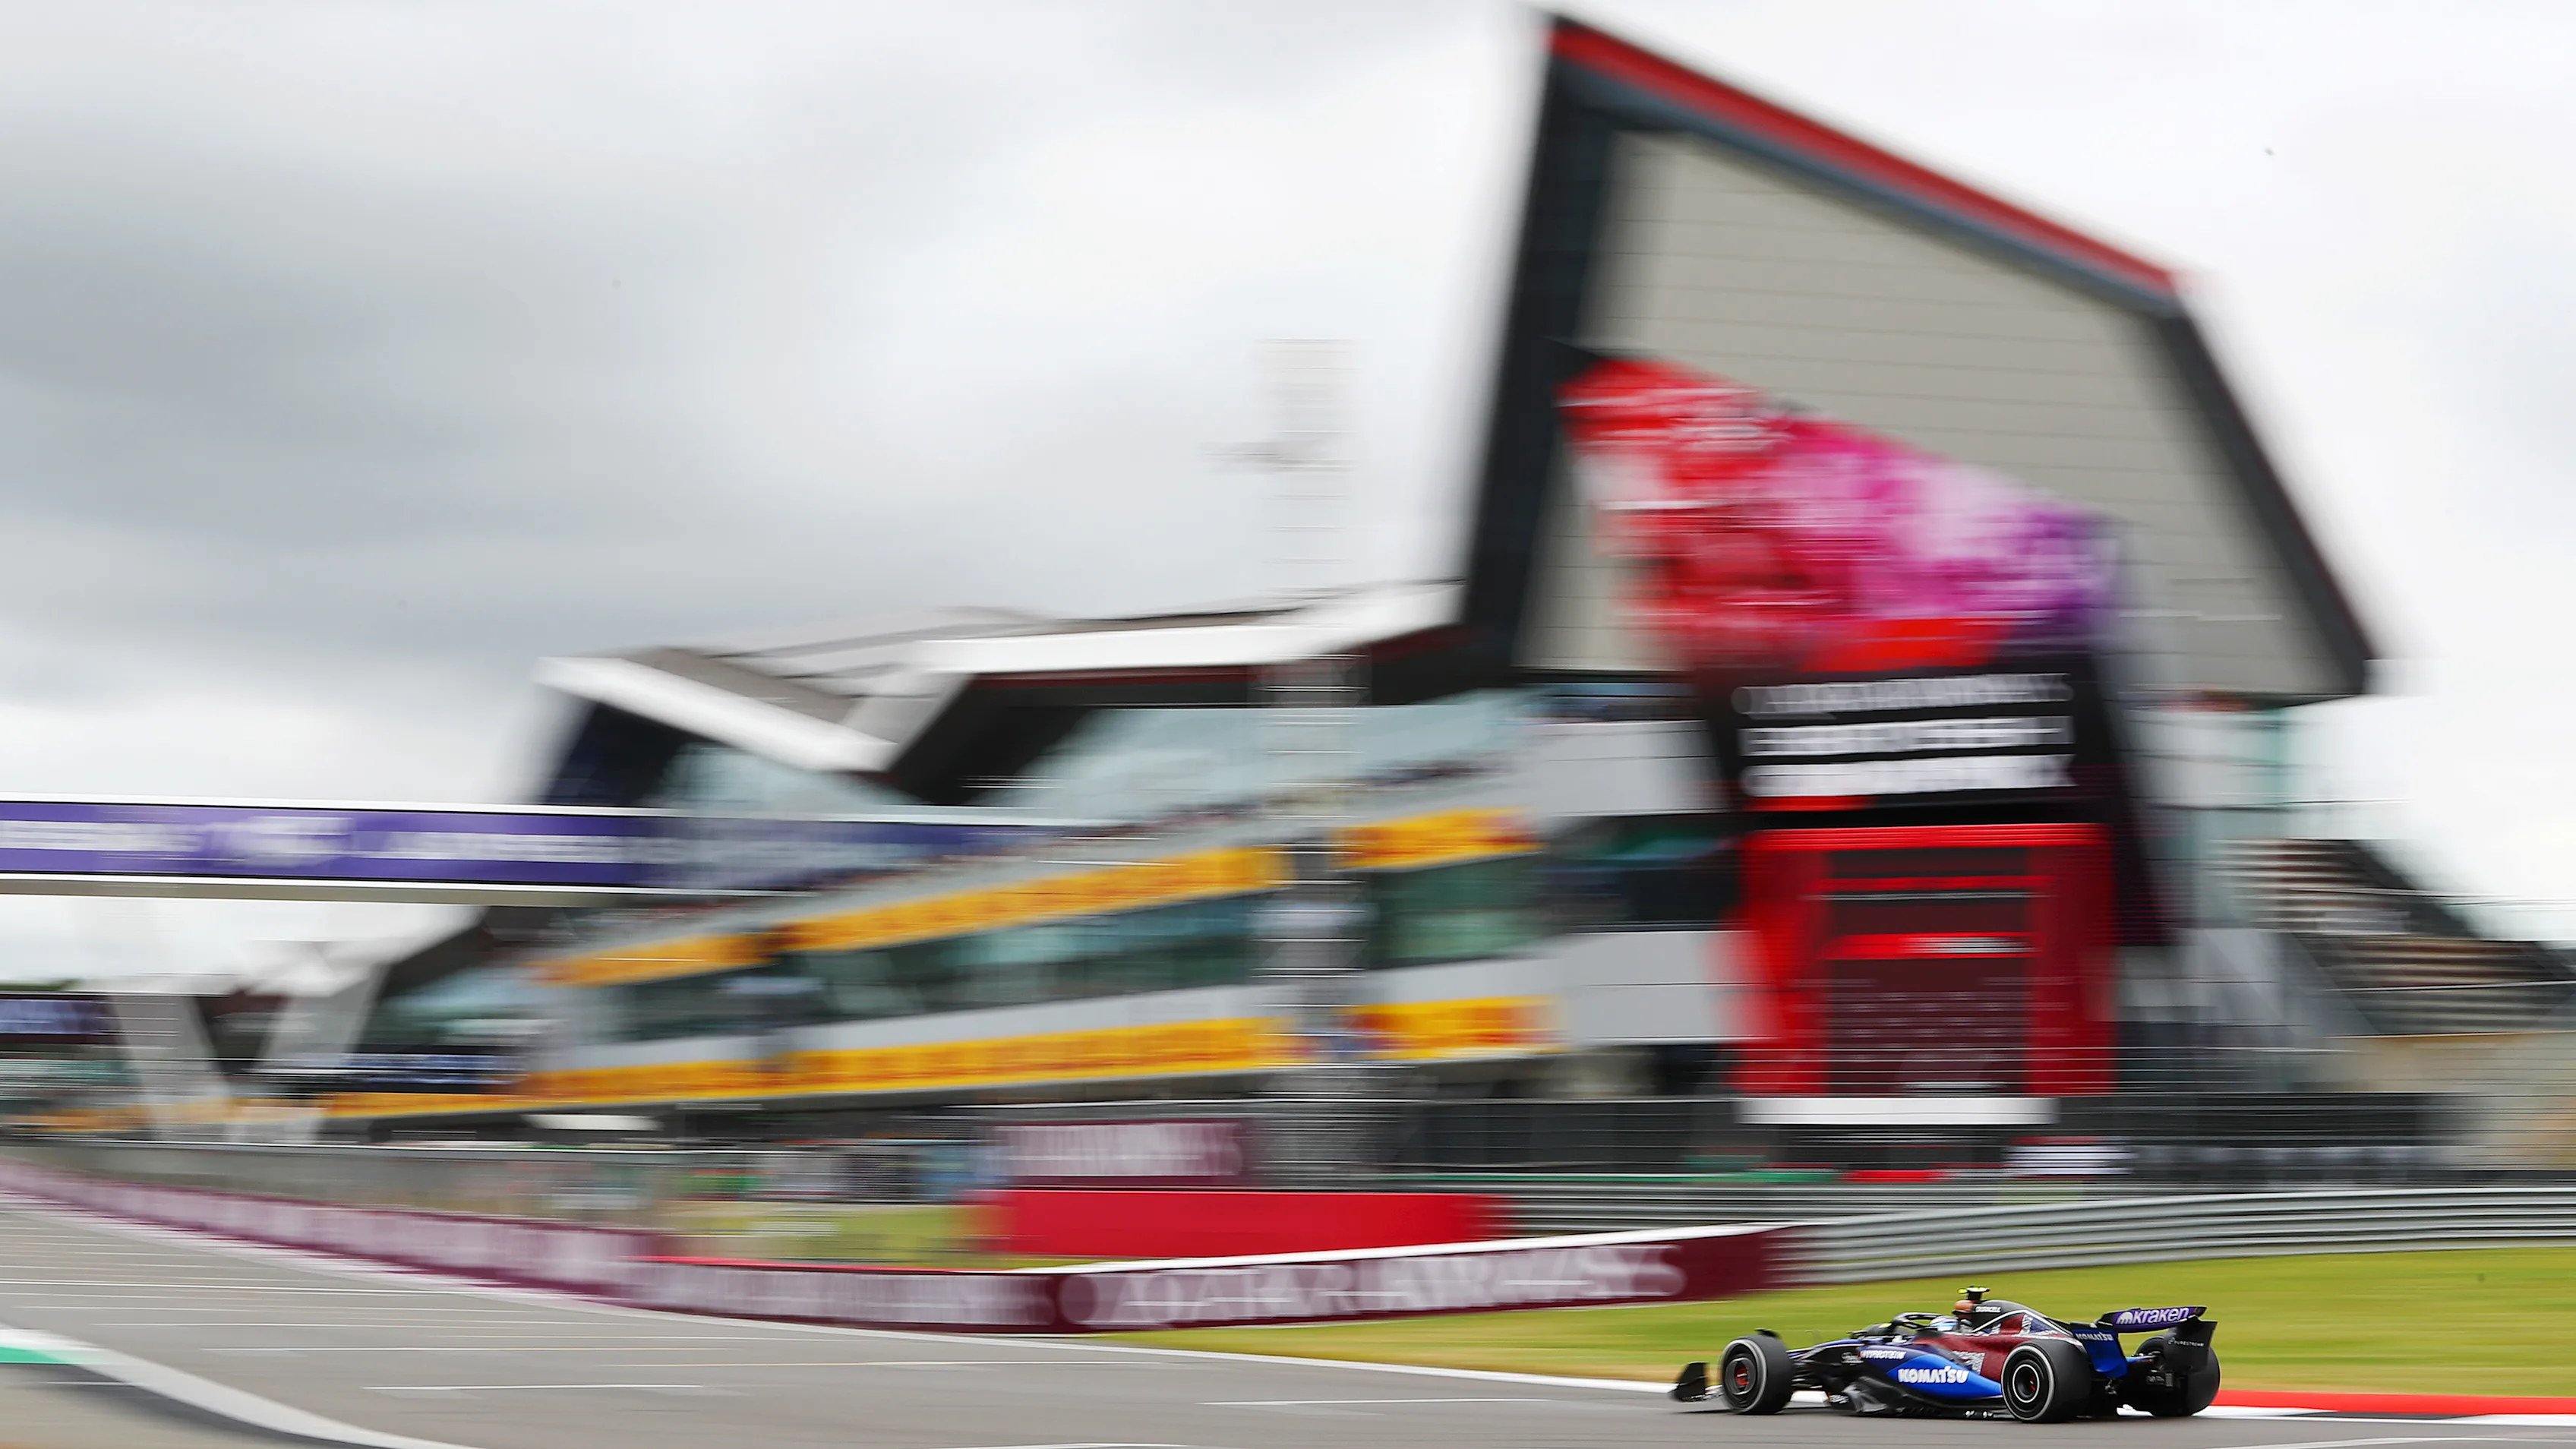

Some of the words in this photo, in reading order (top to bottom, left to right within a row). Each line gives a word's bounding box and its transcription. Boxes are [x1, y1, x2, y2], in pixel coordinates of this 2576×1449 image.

[2132, 1307, 2189, 1324] kraken
[2075, 1331, 2114, 1341] KOMATSU
[1898, 1365, 1969, 1383] KOMATSU
